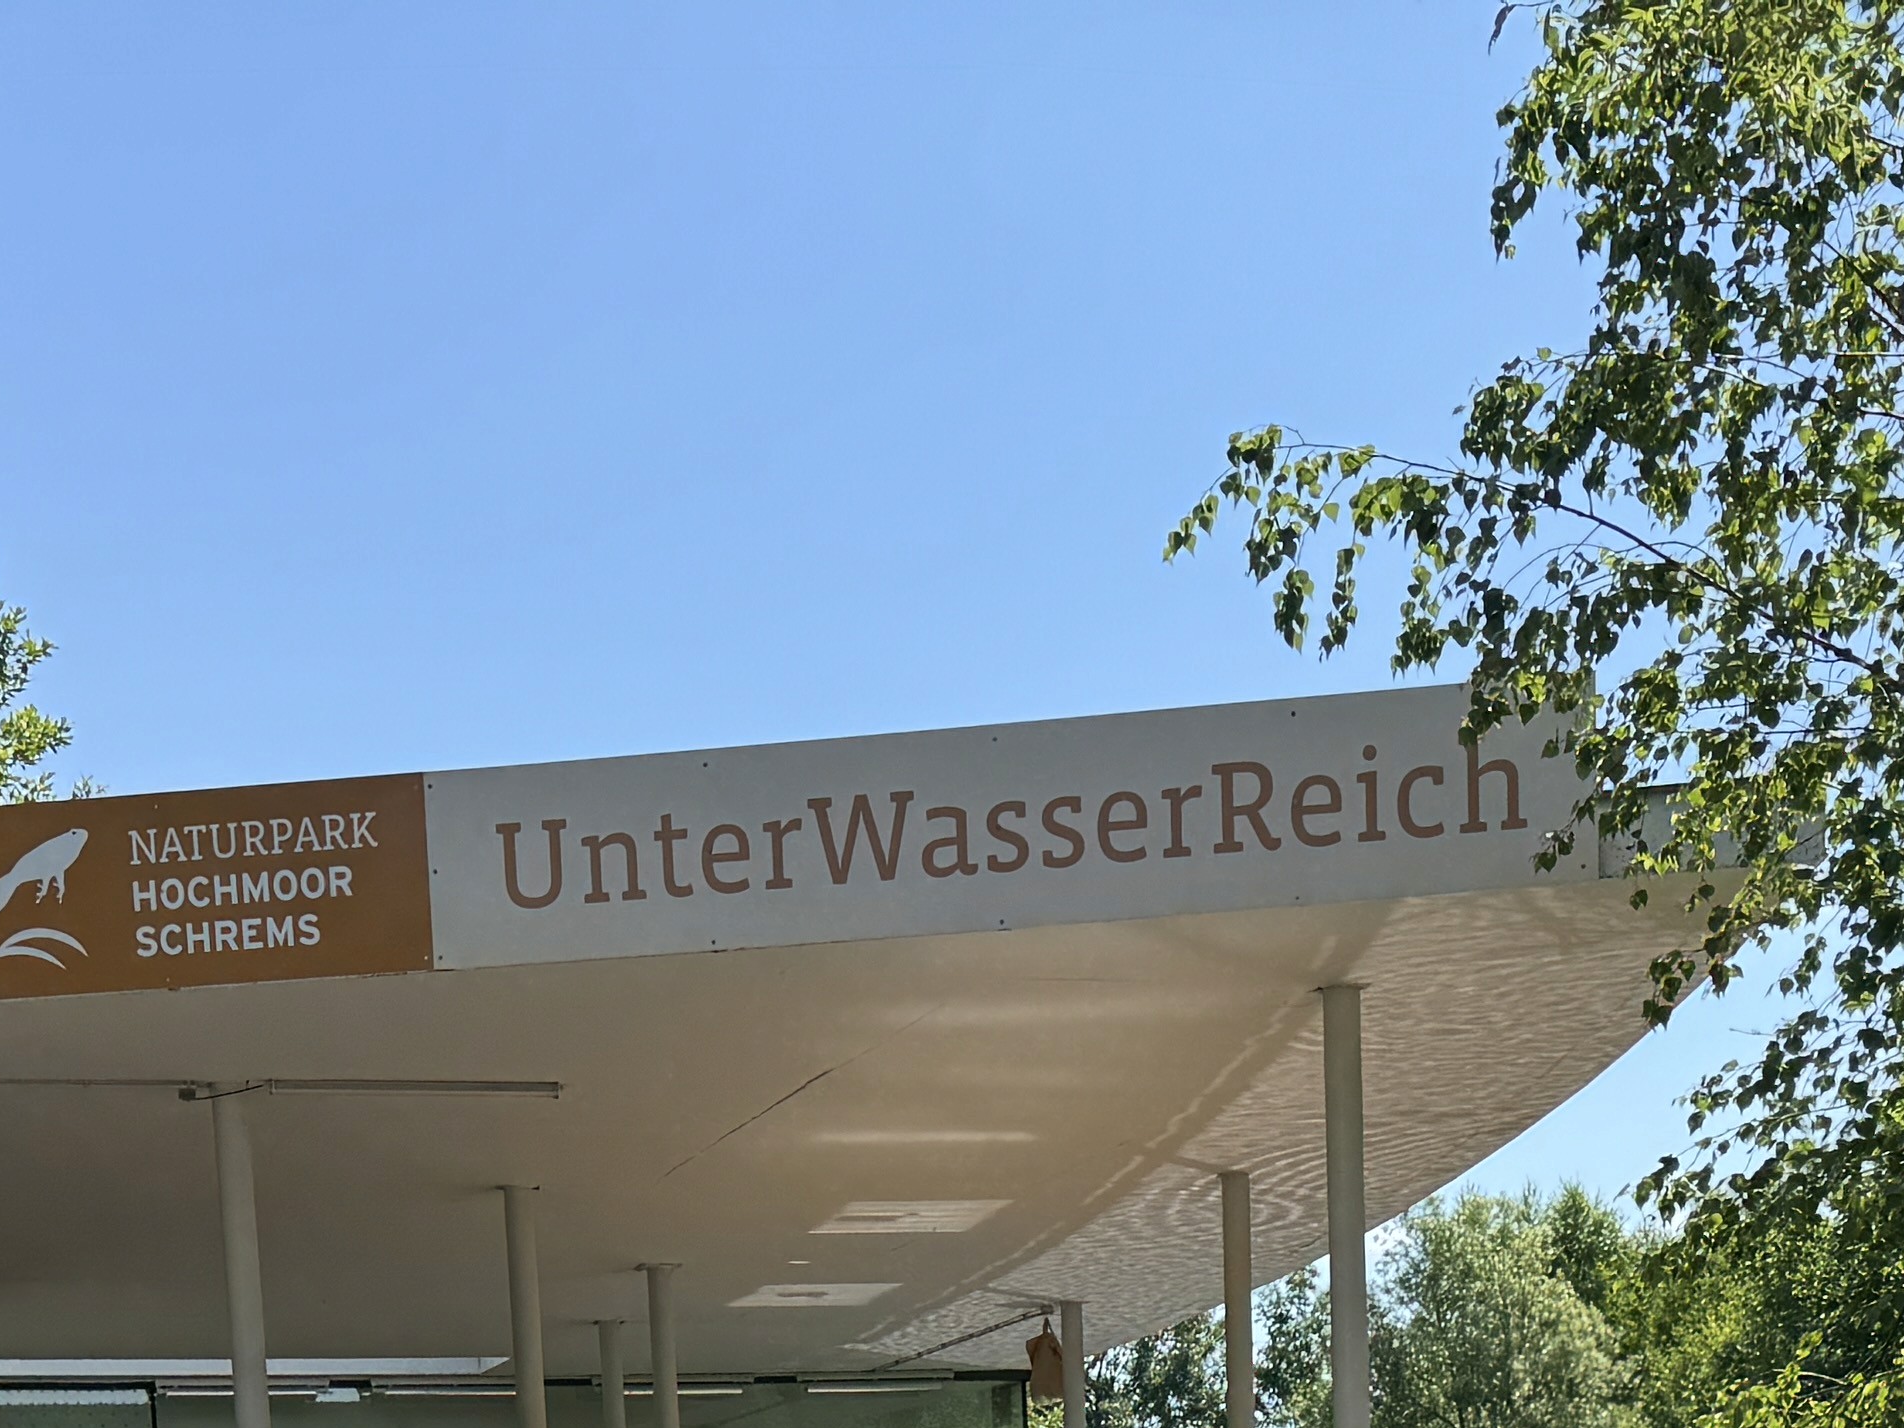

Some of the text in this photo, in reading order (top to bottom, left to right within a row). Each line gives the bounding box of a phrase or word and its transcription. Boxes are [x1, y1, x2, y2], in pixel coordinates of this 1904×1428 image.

[128, 811, 378, 865] NATURPARK
[496, 740, 1528, 909] UnterWasserReich
[132, 865, 353, 912] HOCHMOOR
[136, 913, 321, 958] SCHREMS
